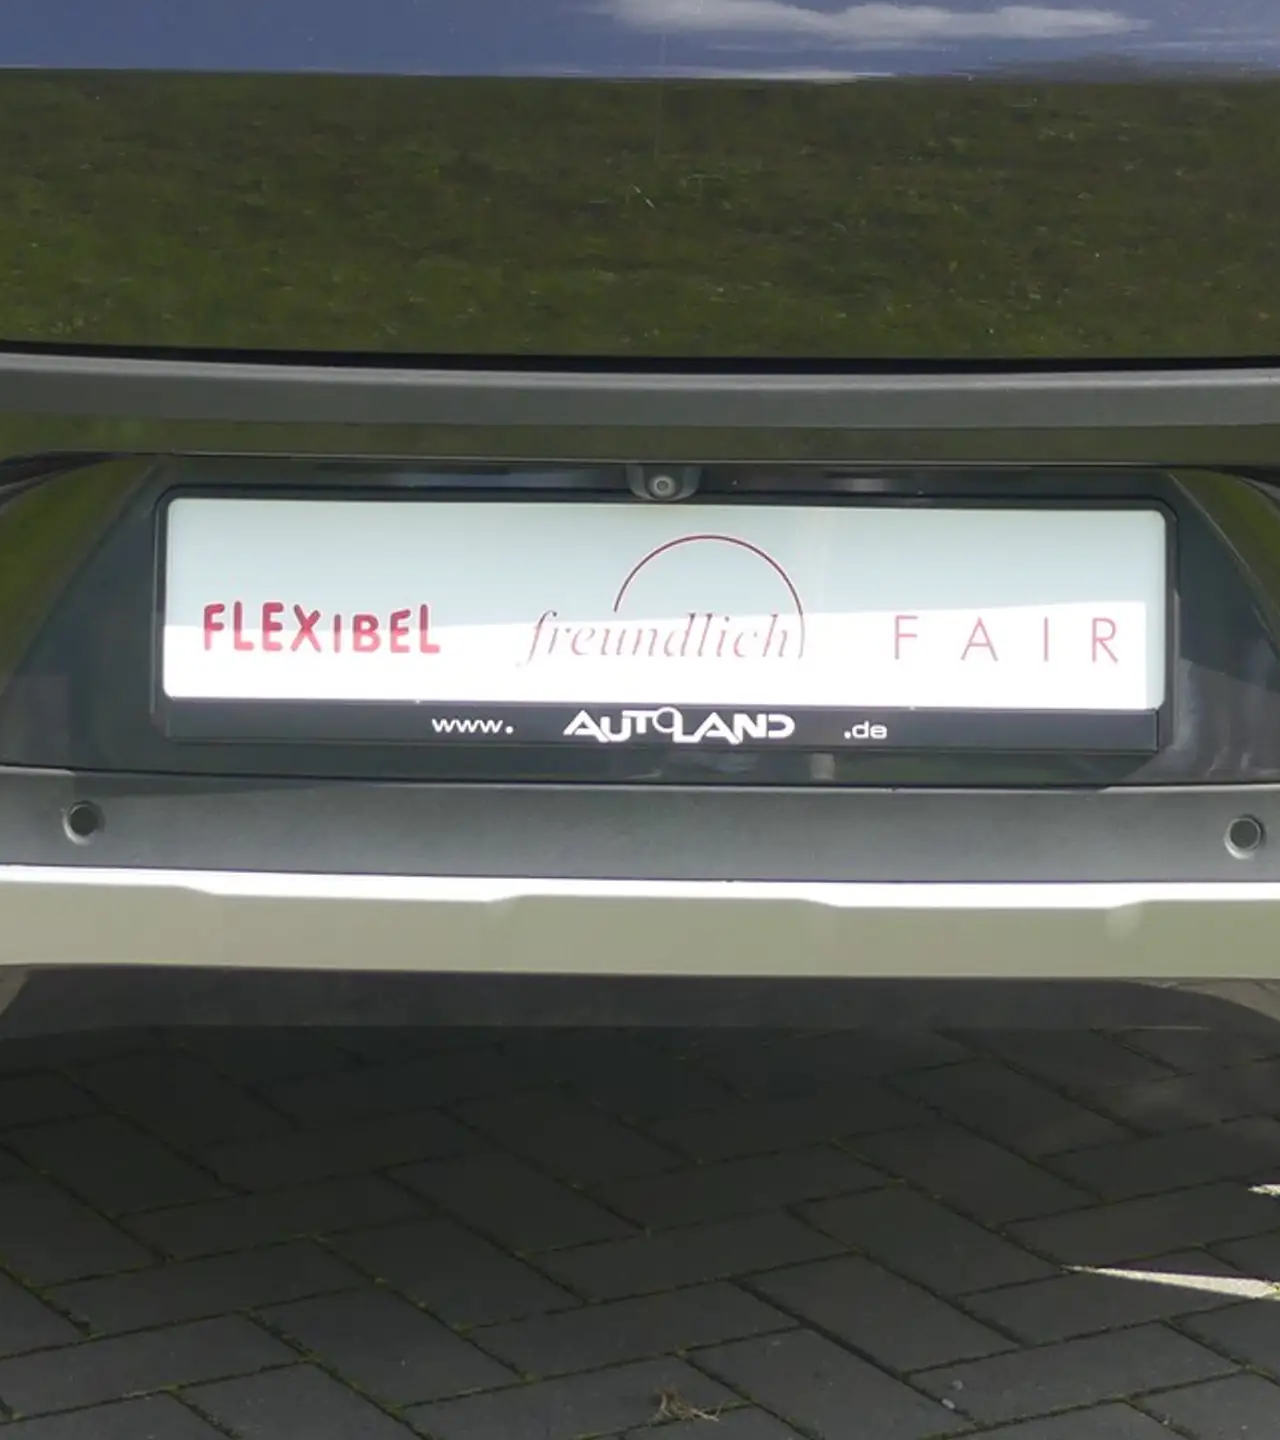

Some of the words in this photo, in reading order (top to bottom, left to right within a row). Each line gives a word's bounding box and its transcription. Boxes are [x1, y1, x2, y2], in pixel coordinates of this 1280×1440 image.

[203, 600, 441, 655] FLEXIBEL
[516, 610, 788, 666] freundlich
[893, 613, 1120, 664] FAIR
[431, 716, 515, 735] www.
[563, 705, 796, 745] AUTOLAND
[843, 719, 888, 740] .de
